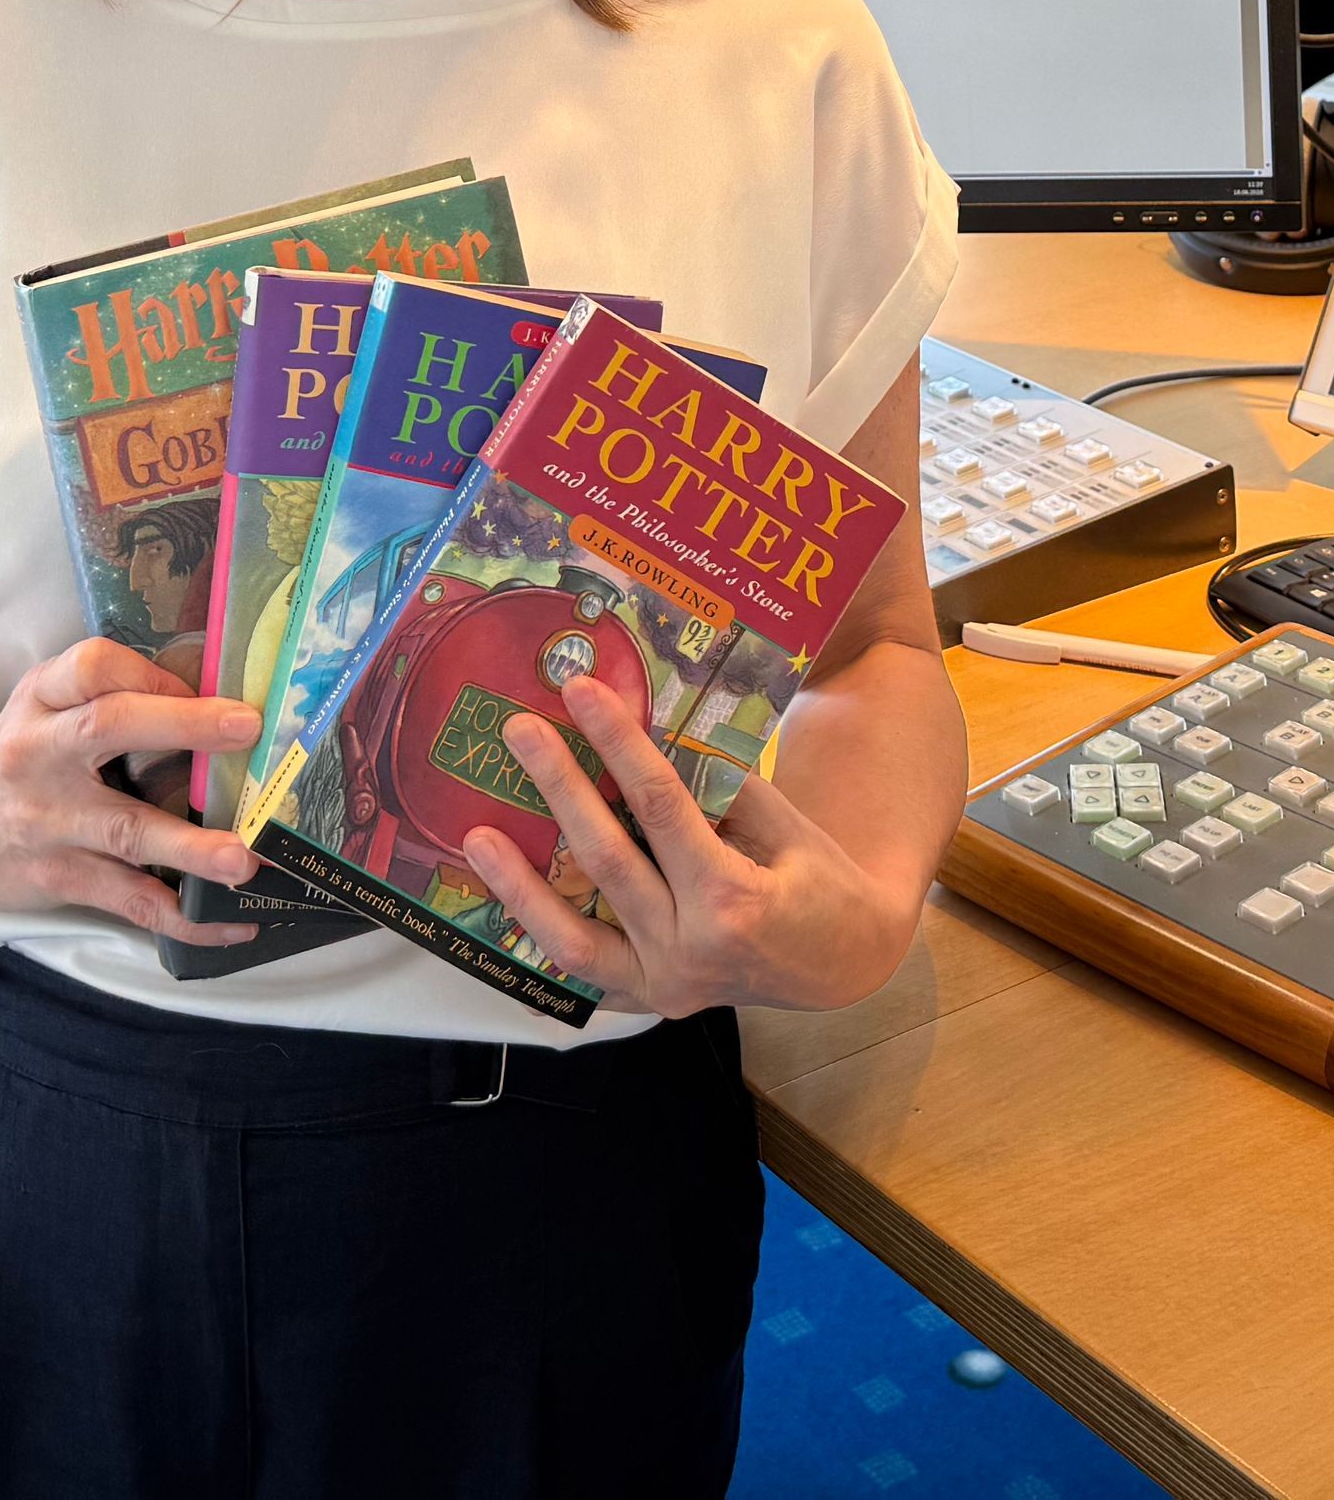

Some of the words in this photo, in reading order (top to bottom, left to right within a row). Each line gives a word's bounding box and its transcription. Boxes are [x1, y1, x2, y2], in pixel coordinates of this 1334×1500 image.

[524, 338, 564, 397] HARRY
[280, 431, 326, 450] and
[483, 397, 526, 458] POTTER
[588, 339, 876, 540] HARRY
[389, 451, 433, 468] and
[440, 460, 465, 477] th
[547, 392, 836, 608] POTTER
[542, 462, 587, 489] and
[585, 482, 617, 512] the
[618, 502, 739, 586] Philosopher's
[741, 579, 794, 622] Stone
[378, 587, 404, 626] Stone
[306, 669, 352, 736] ROWLING
[1188, 694, 1201, 702] A
[1224, 674, 1237, 683] A
[1280, 732, 1294, 740] B
[327, 866, 344, 892] is
[342, 880, 352, 892] a
[355, 884, 401, 919] terrific
[447, 934, 475, 961] The
[473, 952, 520, 991] Sunday
[520, 976, 575, 1016] Telegraph
